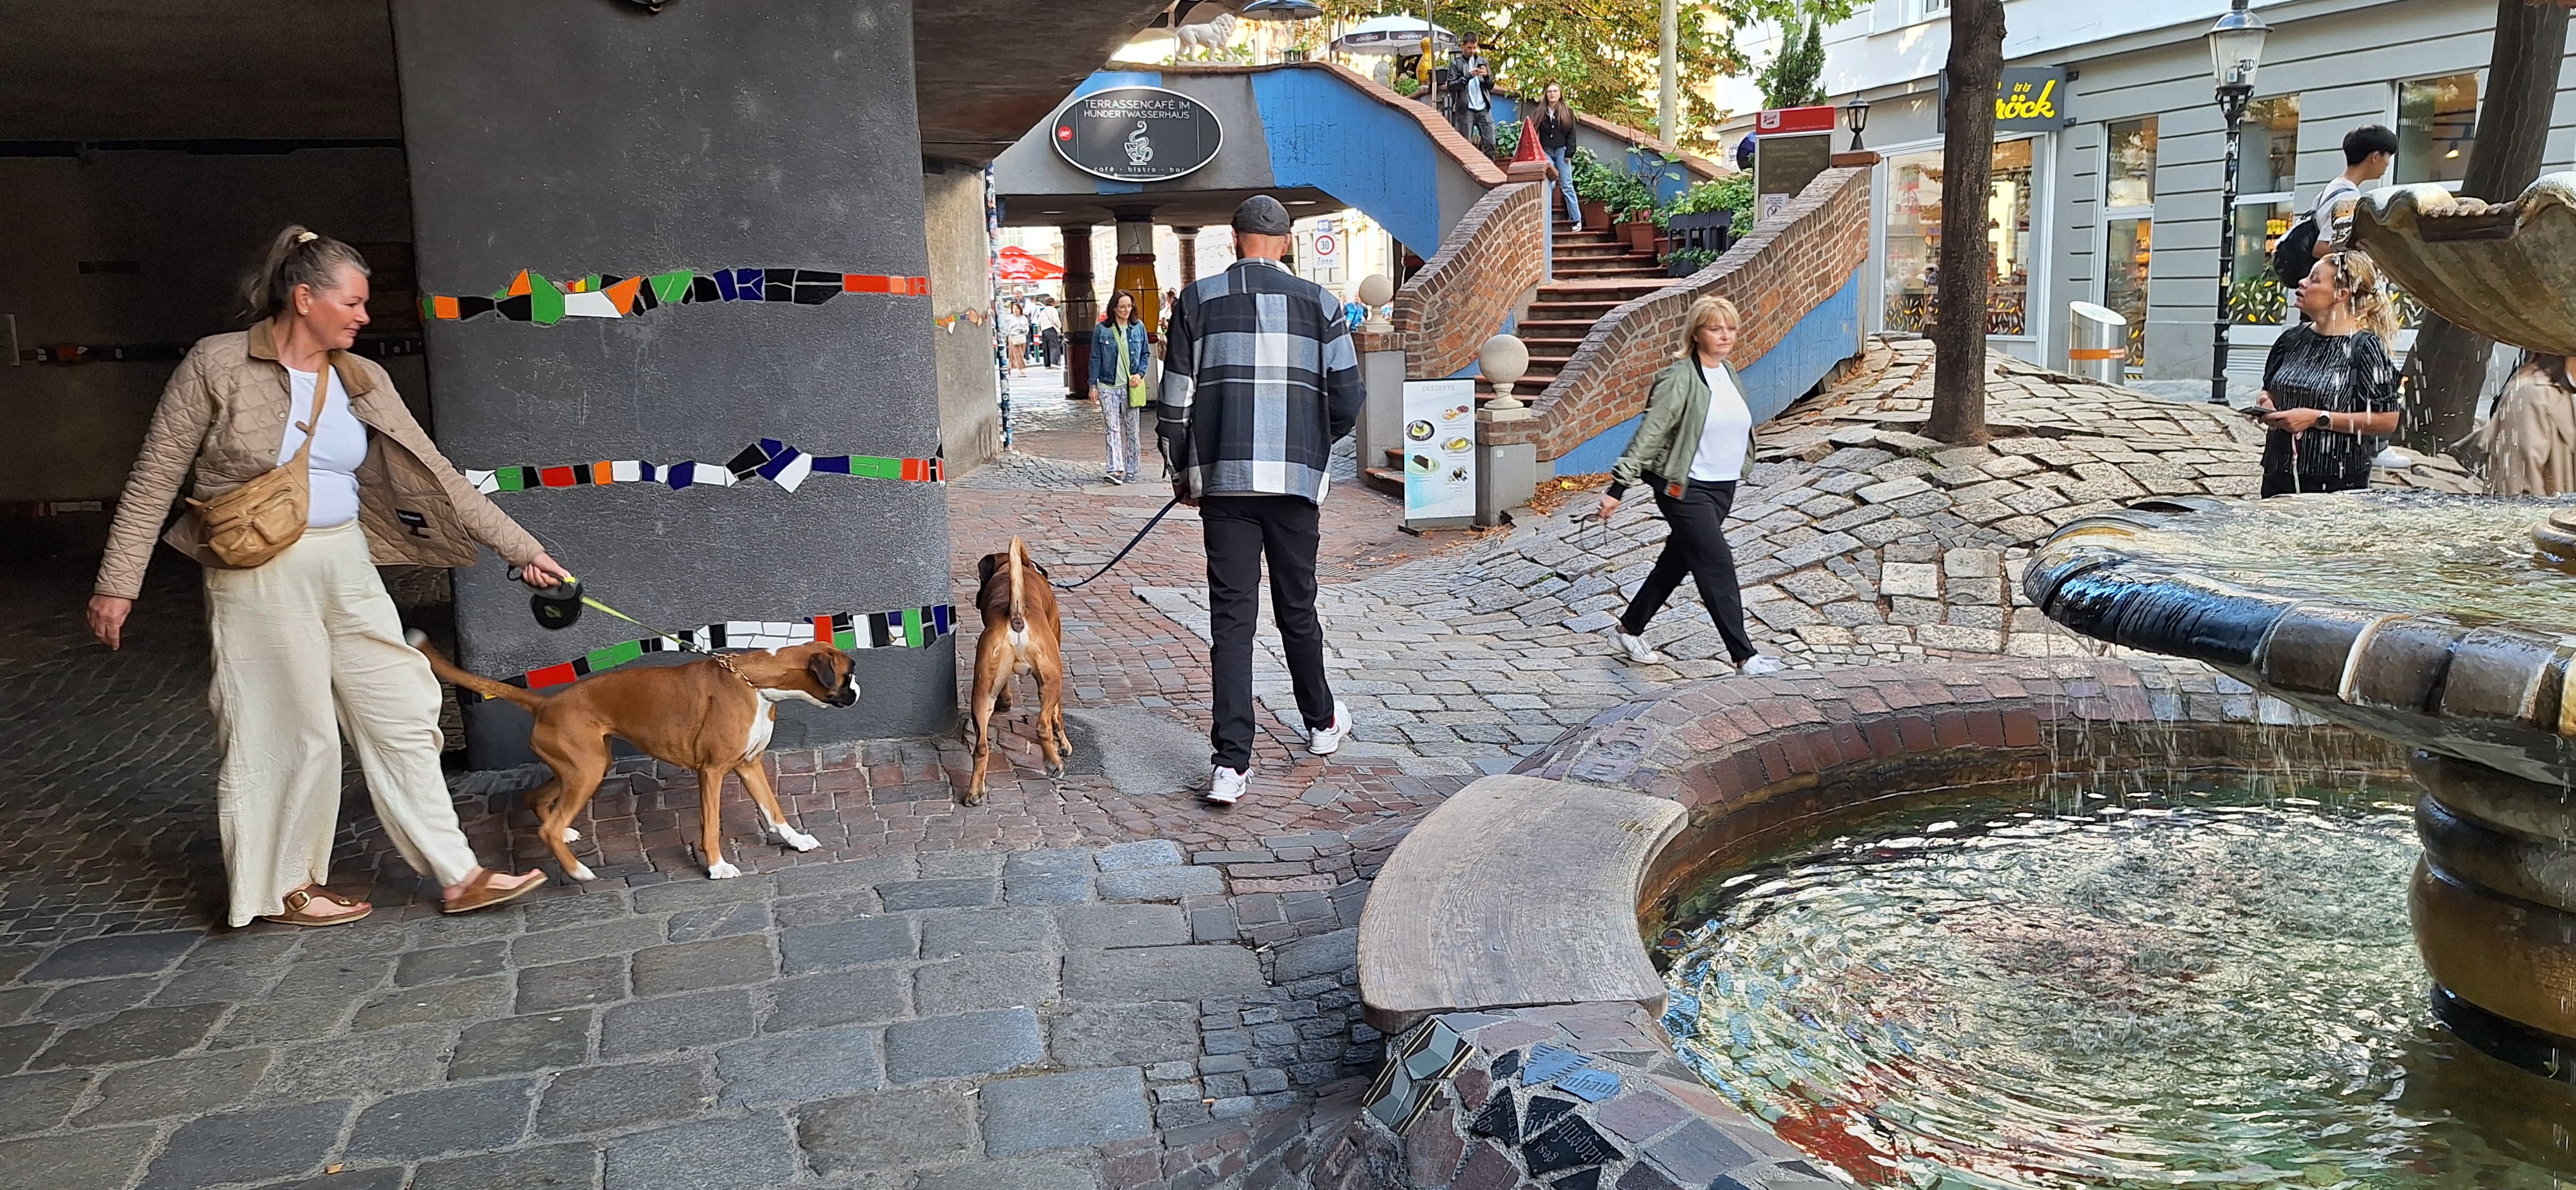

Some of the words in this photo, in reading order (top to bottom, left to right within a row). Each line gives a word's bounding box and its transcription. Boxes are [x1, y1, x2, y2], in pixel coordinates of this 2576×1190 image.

[1083, 99, 1176, 109] TERRASSENCAFÉ
[1179, 100, 1190, 110] IM
[1996, 80, 2056, 119] röck
[1083, 110, 1190, 119] HUNDERTWASSERHAUS
[1321, 241, 1330, 250] 30
